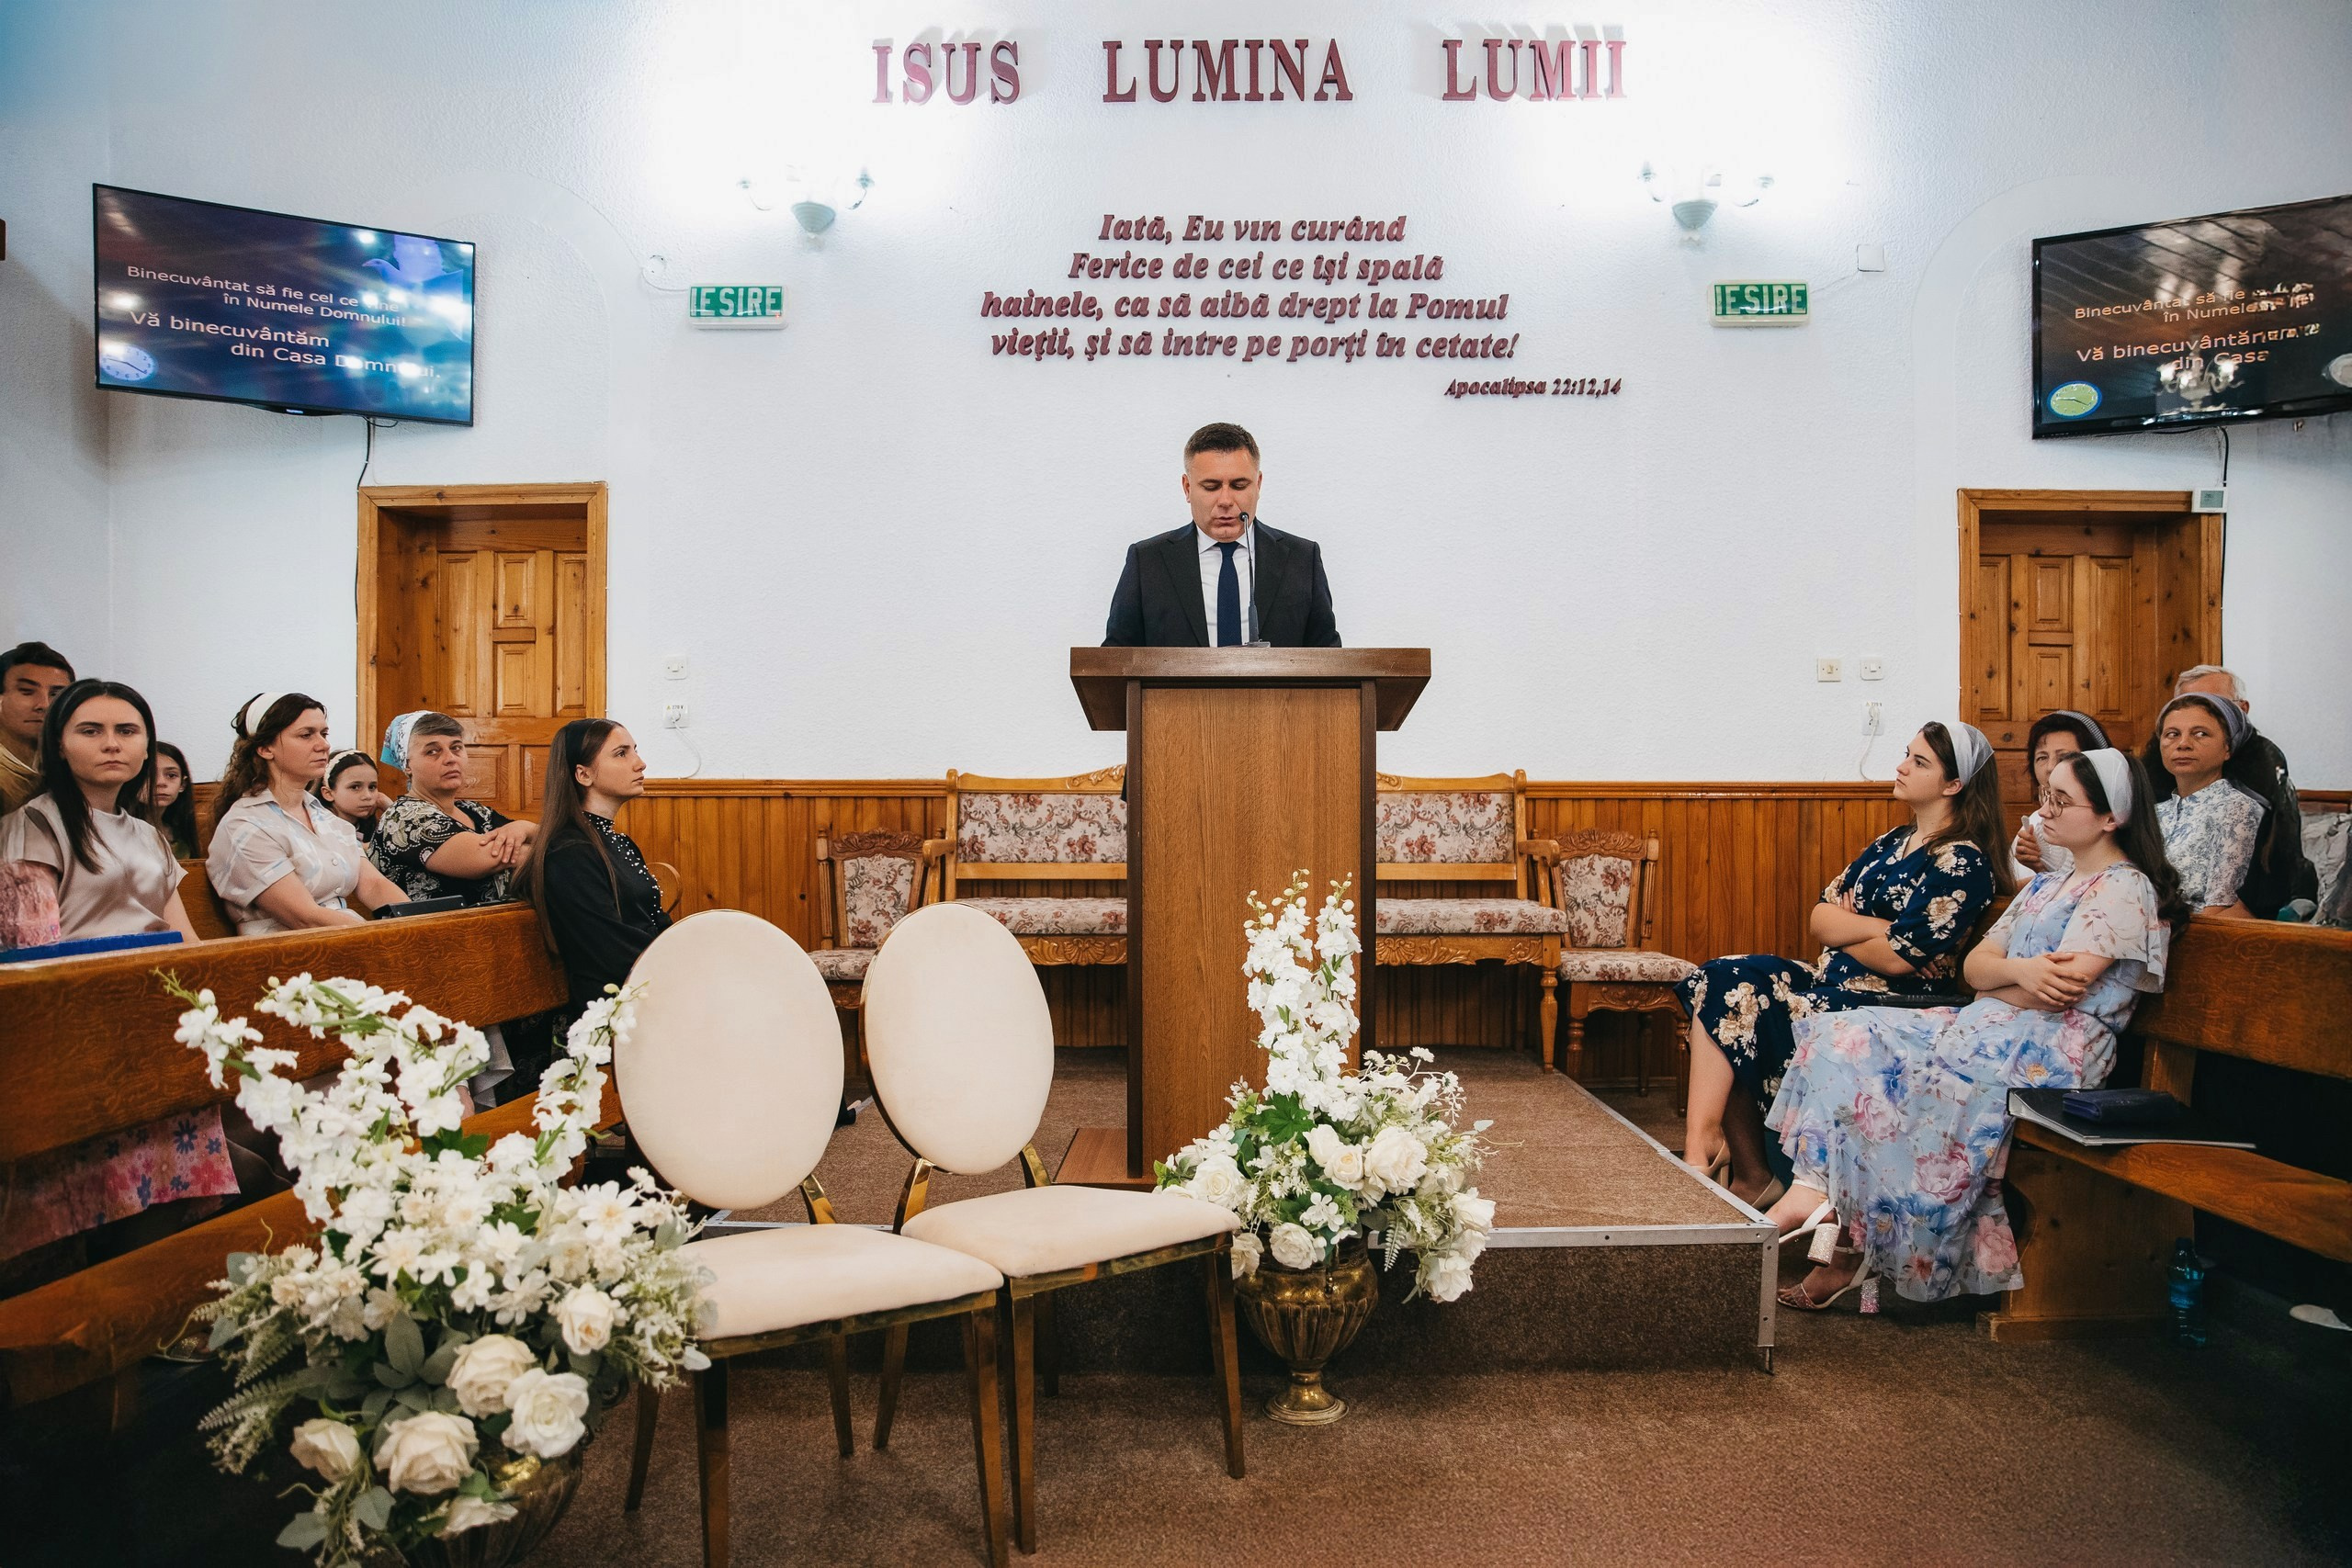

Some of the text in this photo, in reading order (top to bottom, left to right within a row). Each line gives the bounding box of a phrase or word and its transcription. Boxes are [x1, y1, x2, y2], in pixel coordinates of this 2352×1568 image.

[872, 39, 1627, 105] ISUS LUMINA LUMII
[1099, 214, 1172, 245] Iată,
[1182, 216, 1224, 241] Eu
[1291, 215, 1408, 243] curând
[1068, 251, 1164, 279] Ferice
[1173, 253, 1209, 279] de
[1218, 251, 1263, 279] cei
[1272, 258, 1304, 279] ce
[1356, 254, 1444, 286] spală
[127, 265, 250, 293] Binecuvântat
[255, 284, 276, 297] să
[282, 287, 303, 299] fie
[309, 293, 334, 304] cel
[339, 297, 359, 307] ce
[691, 288, 781, 316] IESIRE
[1714, 285, 1806, 315] IESIRE
[222, 293, 406, 327] în Numele Domnului!
[980, 289, 1510, 323] hainele, ca să aibă drept la Pomul
[2075, 298, 2190, 319] Binecuvântat
[2196, 292, 2216, 305] să
[2164, 311, 2179, 322] în
[130, 311, 329, 348] Vă binecuvântăm
[1118, 331, 1152, 356] să
[1161, 328, 1237, 356] intre
[1242, 335, 1282, 362] pe
[1375, 332, 1406, 358] în
[1416, 333, 1520, 359] cetate!
[231, 343, 441, 378] din Casa Dmnui.
[2076, 346, 2104, 362] Vă
[2171, 356, 2204, 370] din
[1443, 377, 1623, 399] Apocalipsa 22:12,14
